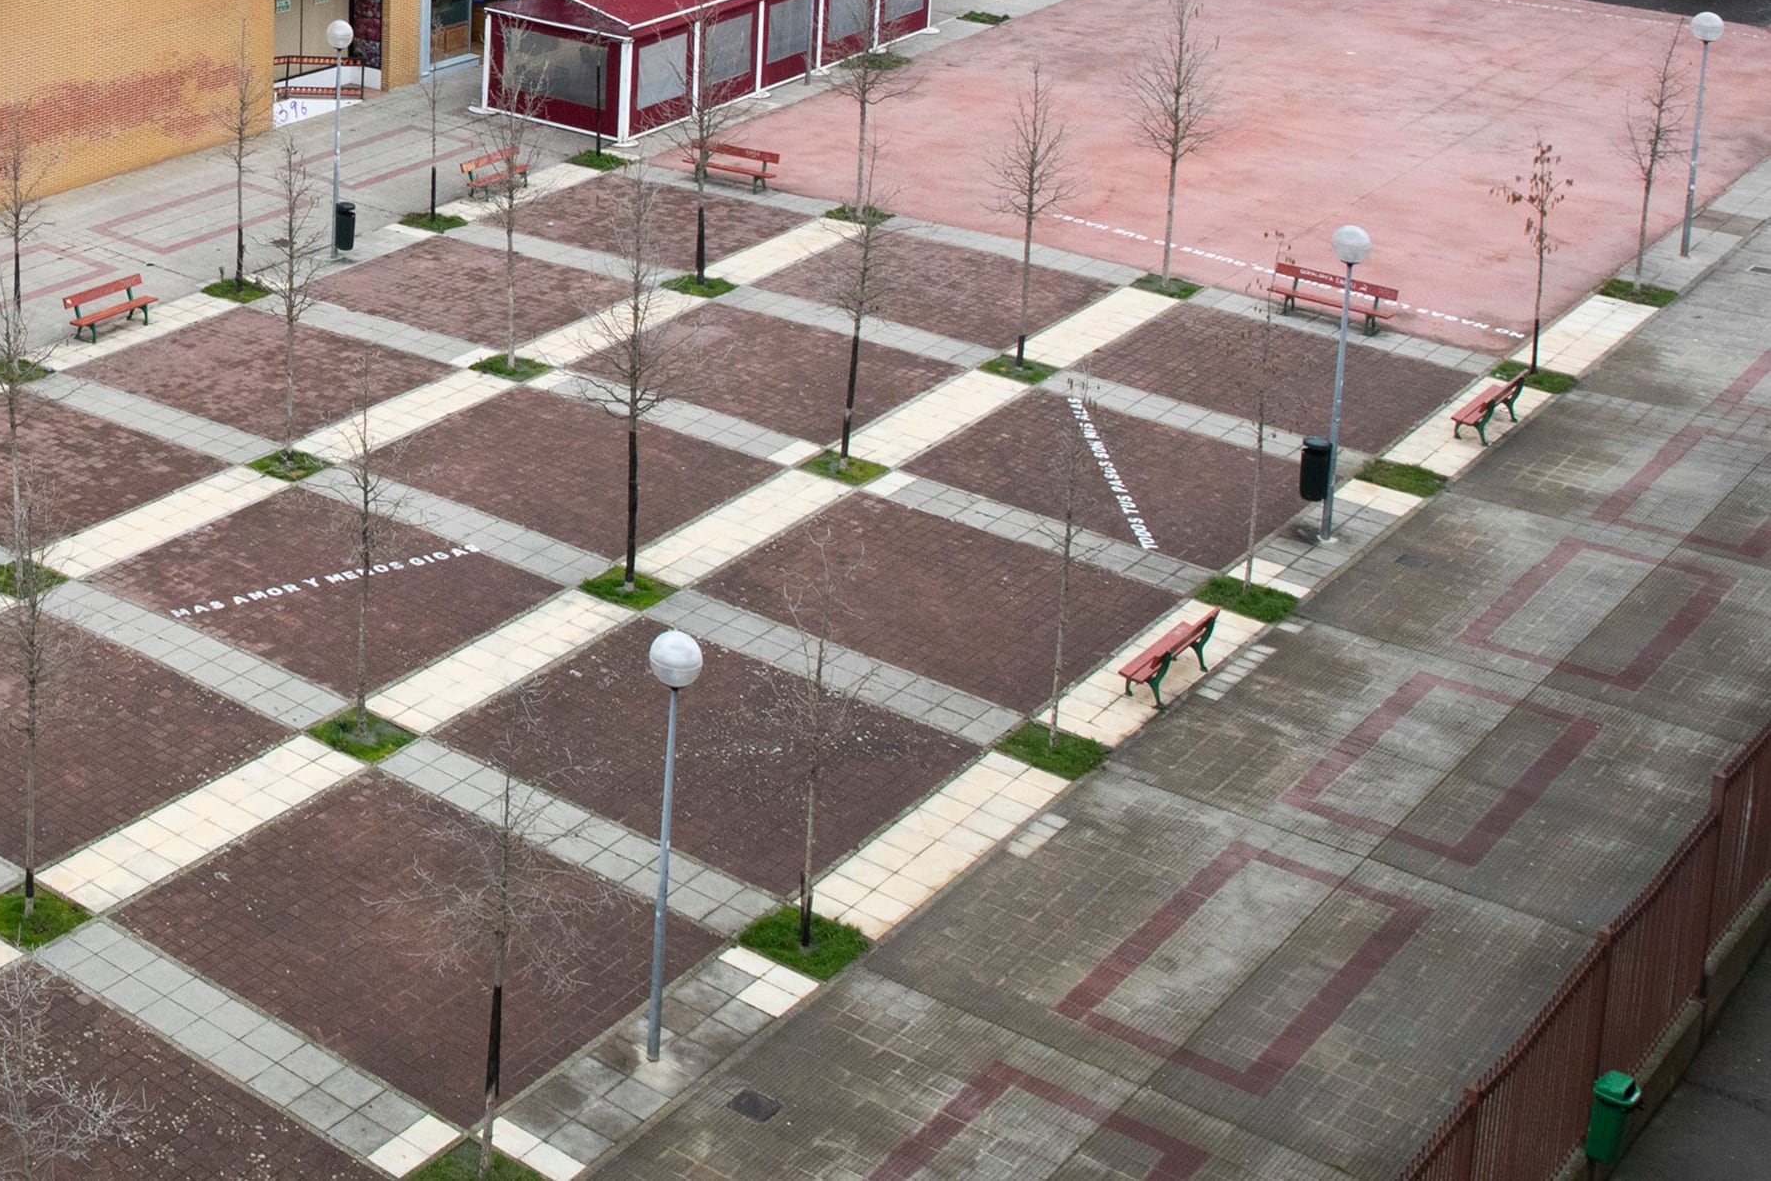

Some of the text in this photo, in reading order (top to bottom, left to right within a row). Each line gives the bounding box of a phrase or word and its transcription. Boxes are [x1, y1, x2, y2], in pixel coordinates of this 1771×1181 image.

[1112, 227, 1149, 242] QUE
[1384, 300, 1414, 314] LO
[1494, 326, 1525, 340] NO
[1098, 460, 1129, 493] PASOS
[1116, 494, 1139, 514] TUS
[1128, 516, 1160, 550] TODOS
[169, 542, 481, 619] MAS AMOR Y MENOS GIGAS
